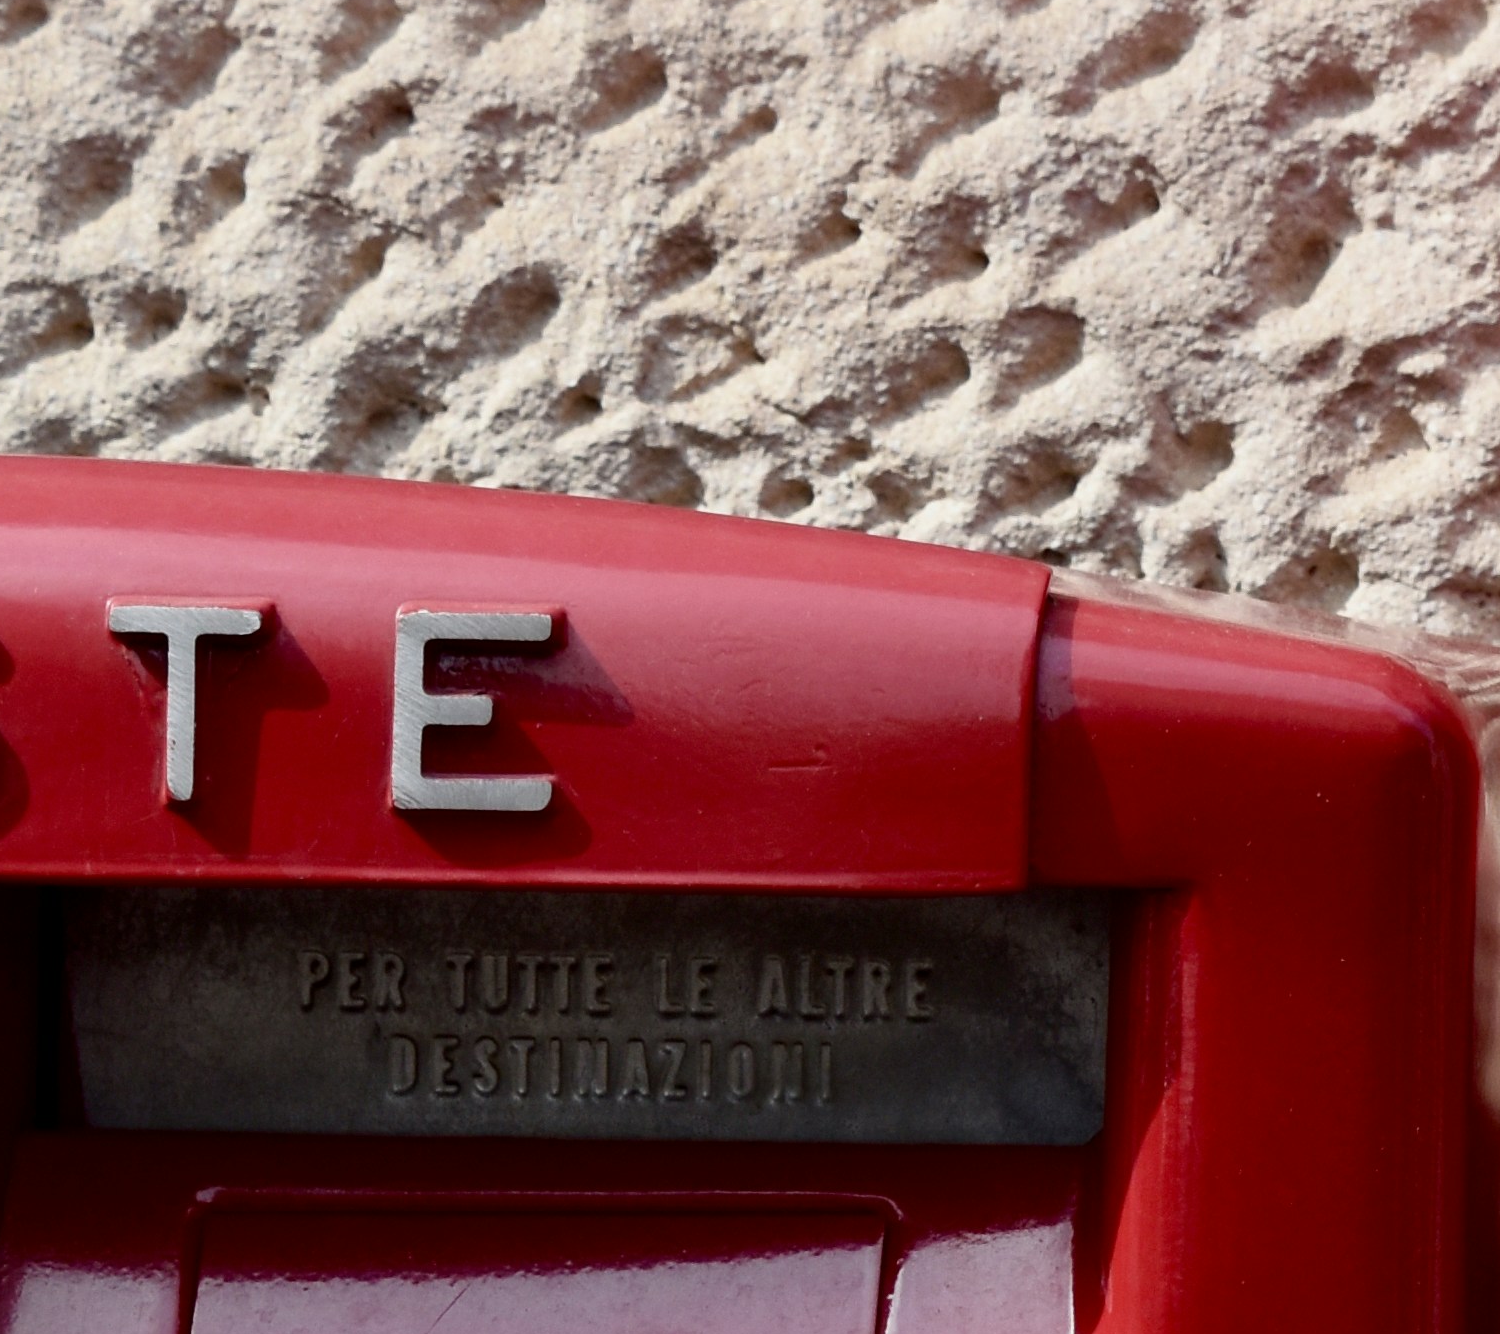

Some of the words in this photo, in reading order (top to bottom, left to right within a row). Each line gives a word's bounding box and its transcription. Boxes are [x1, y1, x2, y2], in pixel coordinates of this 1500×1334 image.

[299, 946, 409, 1014] PER
[445, 950, 617, 1019] TUTTE
[653, 952, 720, 1022] LE
[755, 952, 937, 1025] ALTRE
[385, 1031, 837, 1107] DESTINAZIONI
